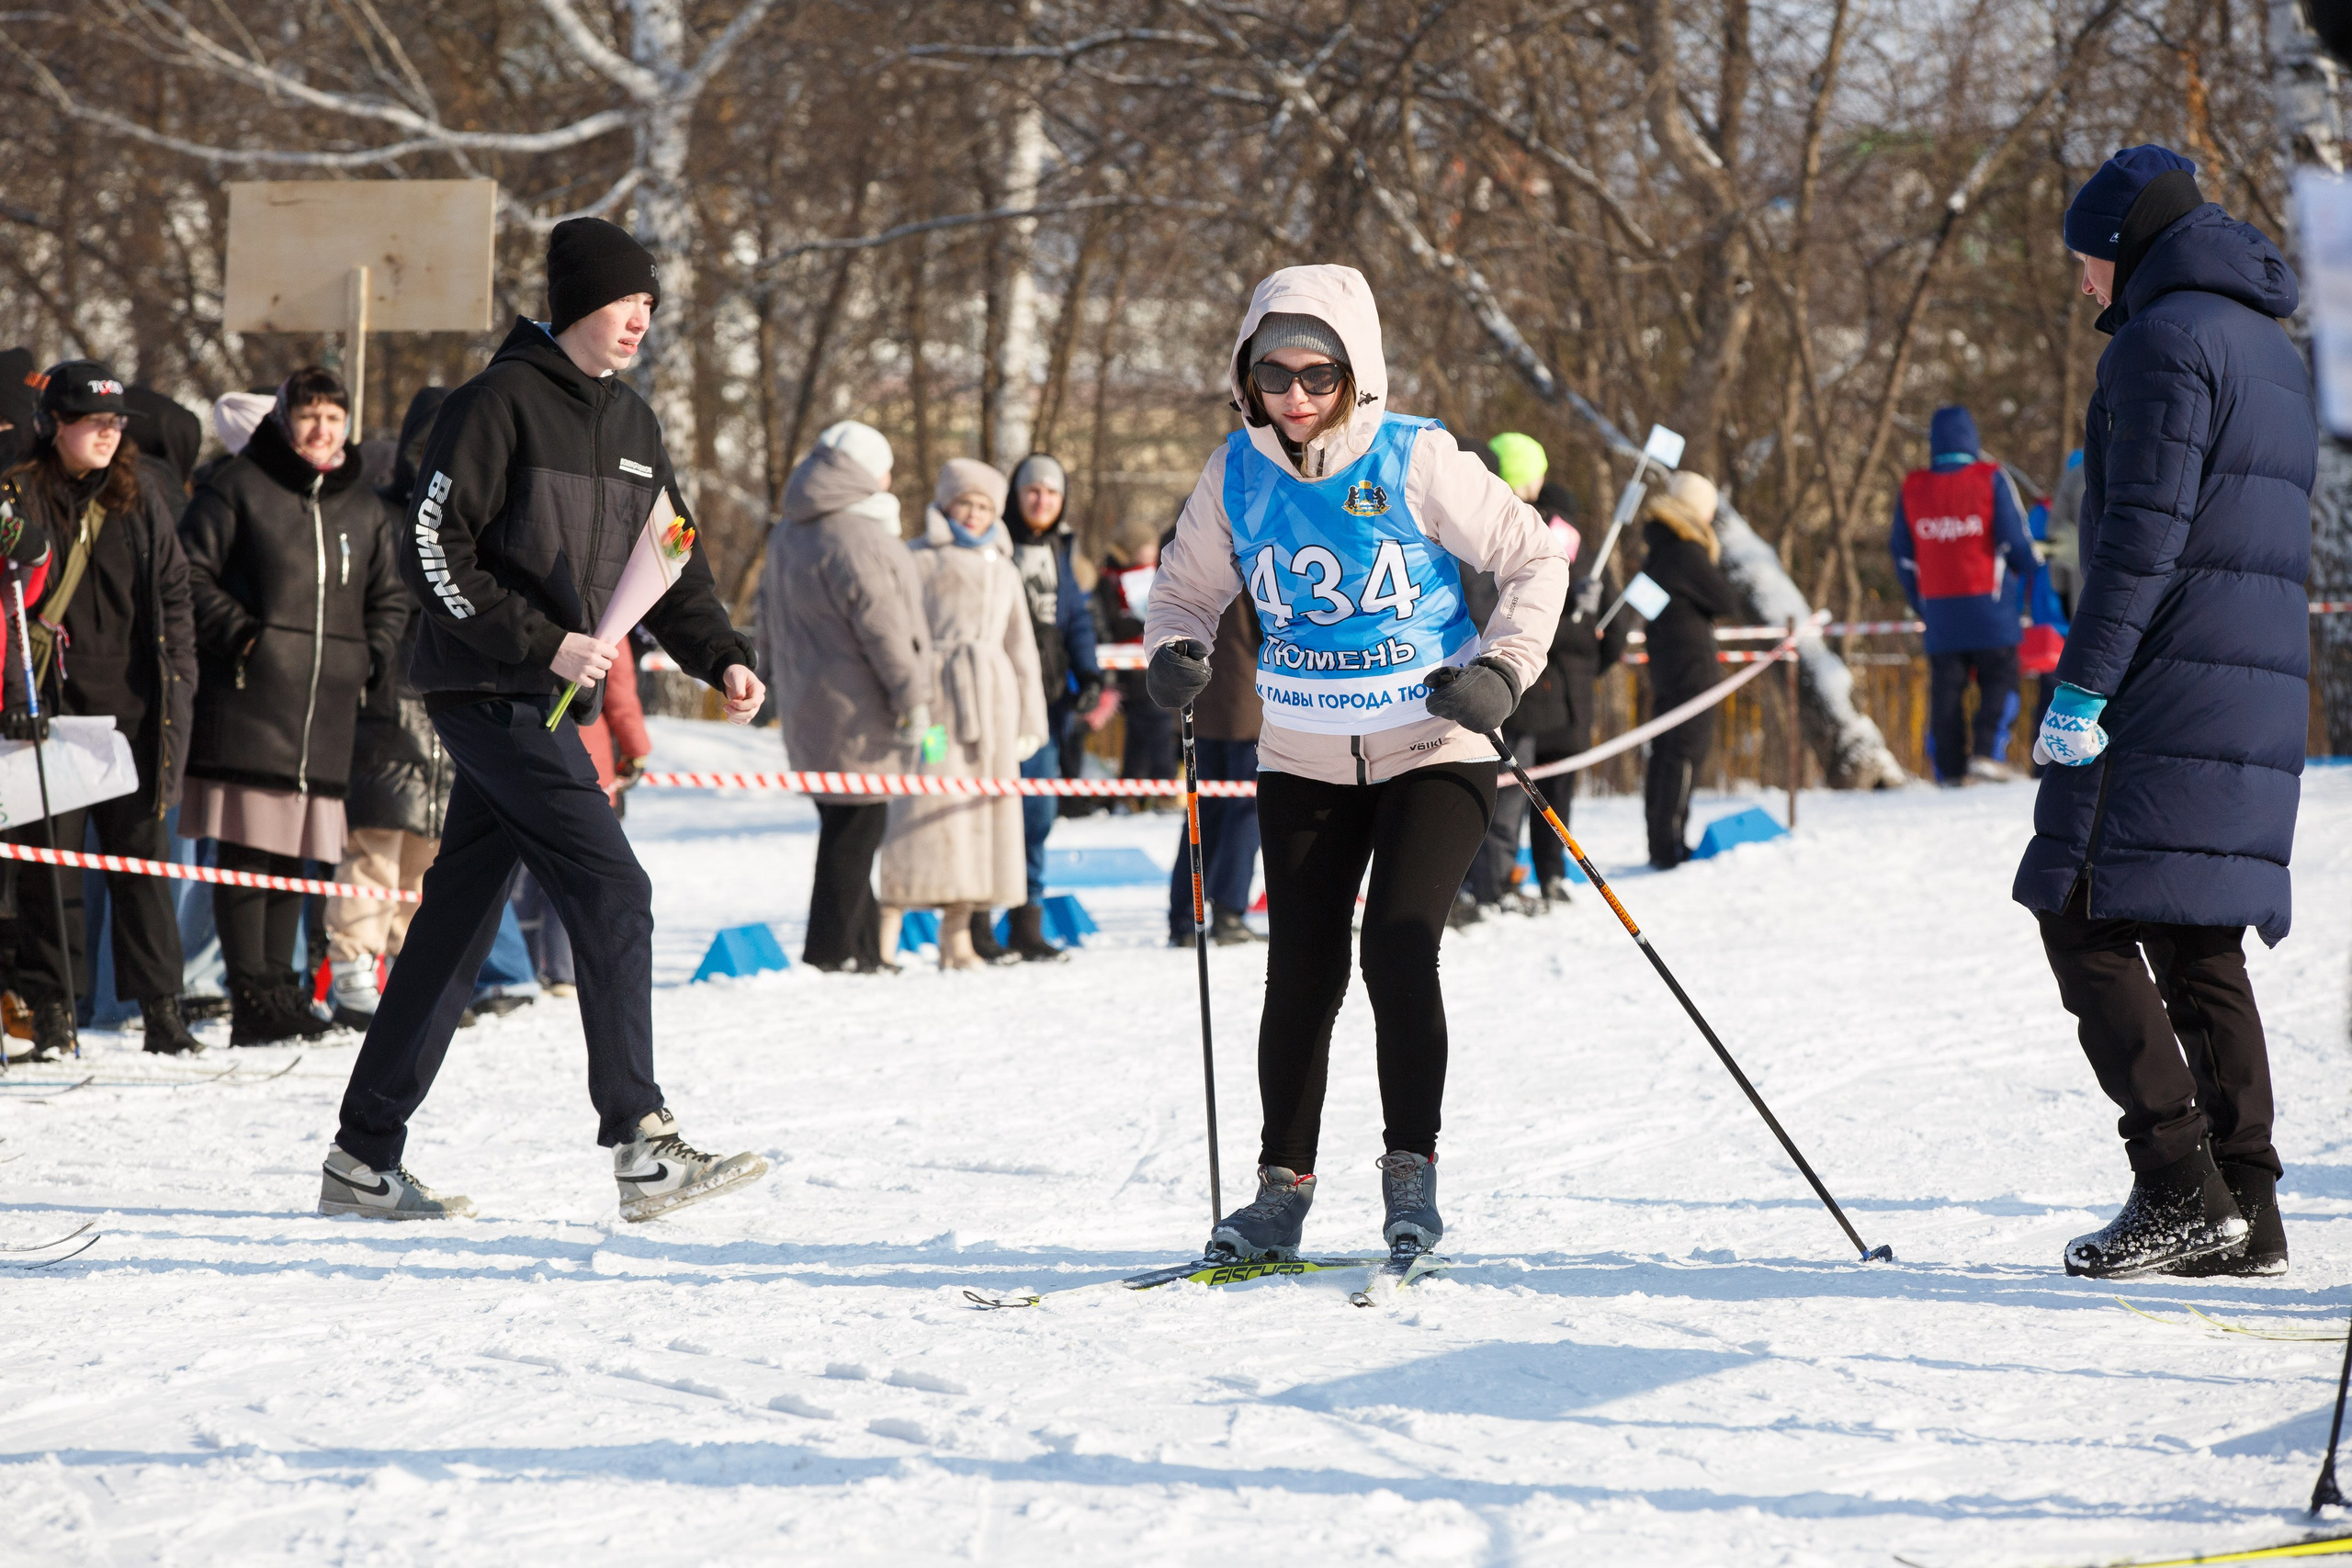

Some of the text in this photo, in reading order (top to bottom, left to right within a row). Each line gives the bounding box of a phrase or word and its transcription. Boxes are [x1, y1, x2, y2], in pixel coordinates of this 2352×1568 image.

[415, 470, 476, 620] BOMING
[1250, 539, 1421, 628] 434
[1263, 634, 1416, 671] ТЮМЕНЬ
[1267, 686, 1314, 707] ГЛАВЫ
[1317, 690, 1393, 710] ГОРОДА
[1397, 682, 1434, 702] ТЮ
[1209, 1264, 1305, 1286] FISCHER
